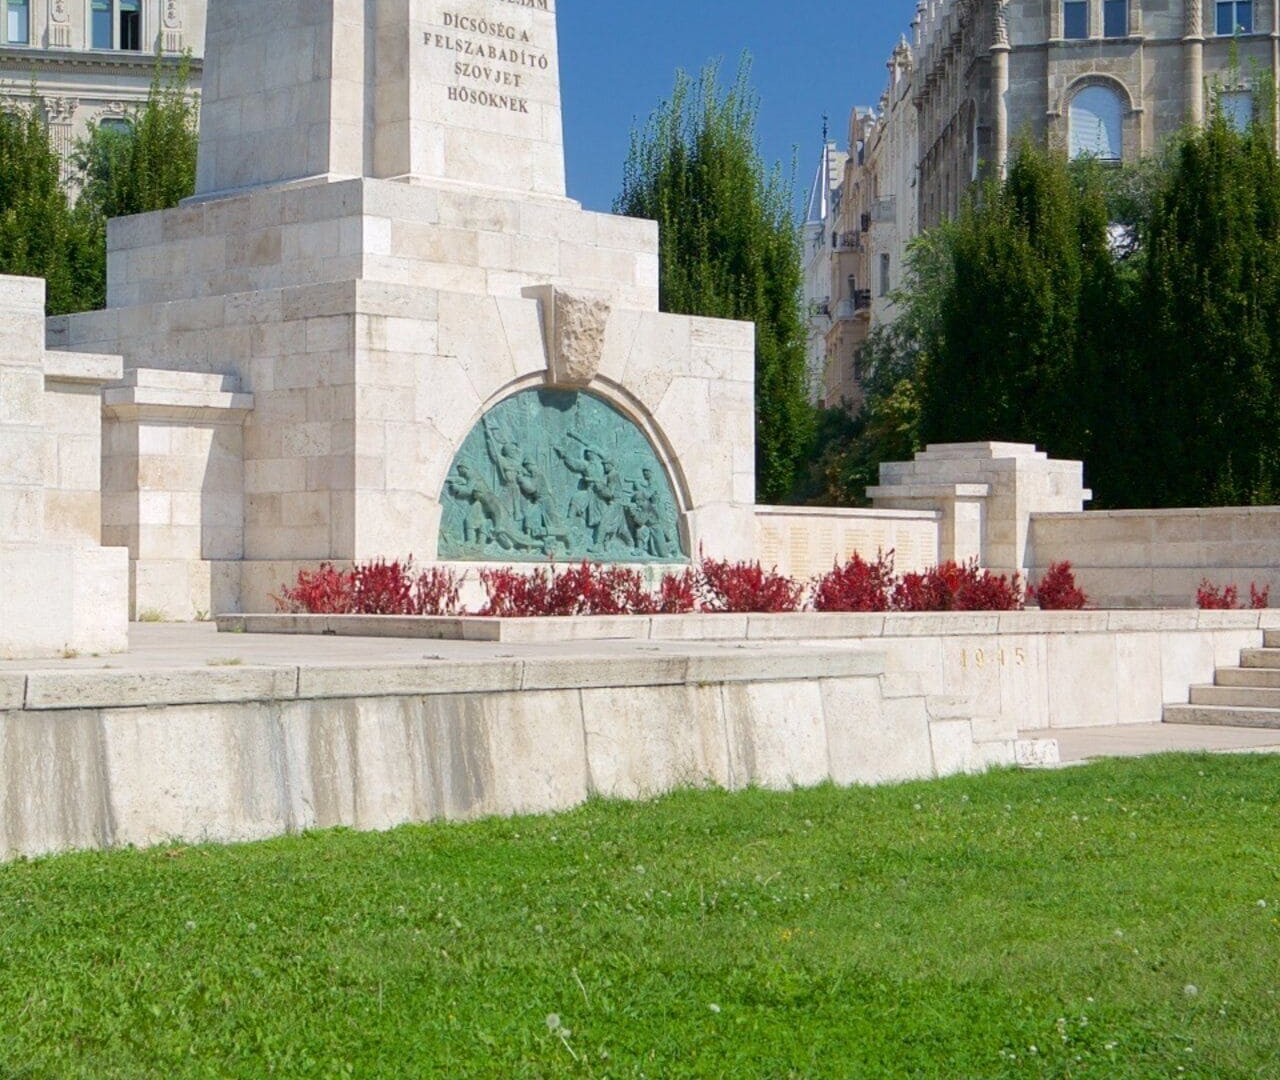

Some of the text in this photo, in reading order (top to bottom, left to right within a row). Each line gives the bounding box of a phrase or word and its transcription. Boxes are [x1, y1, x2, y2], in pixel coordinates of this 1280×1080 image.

[520, 30, 530, 42] A
[423, 32, 548, 70] FELSZABADÍTÓ
[454, 61, 521, 87] SZOVJET
